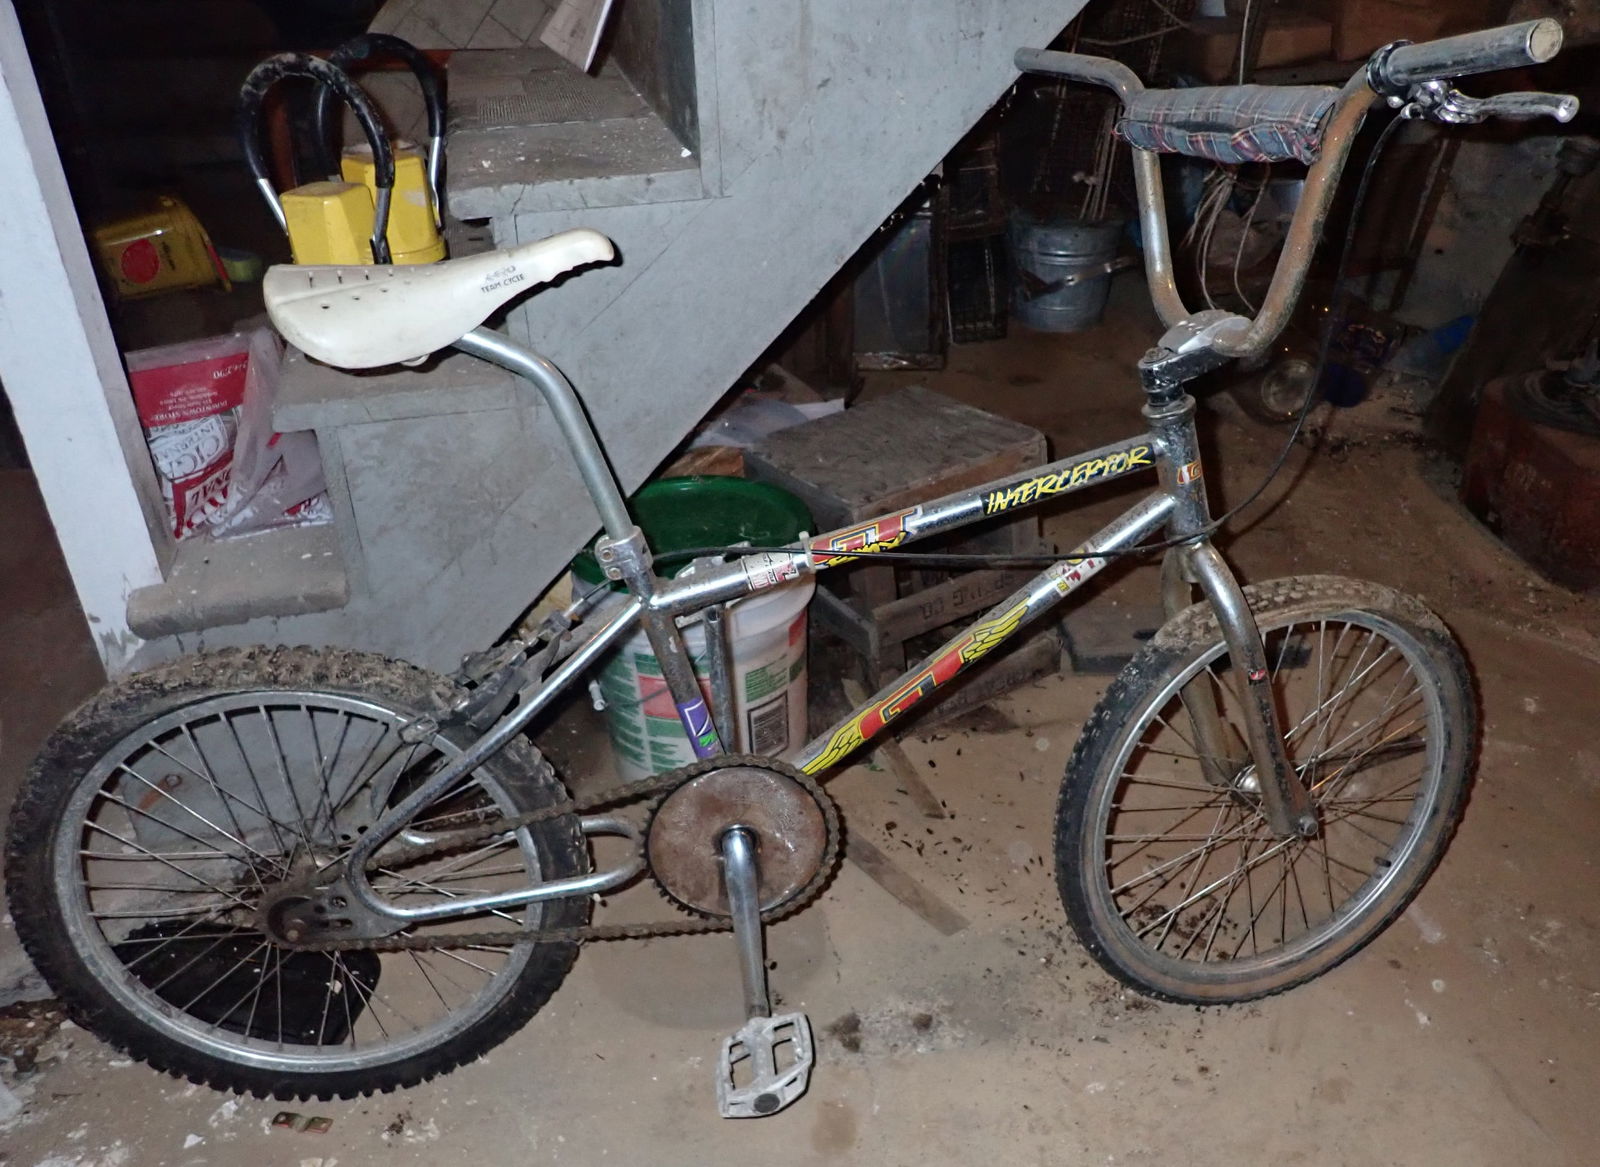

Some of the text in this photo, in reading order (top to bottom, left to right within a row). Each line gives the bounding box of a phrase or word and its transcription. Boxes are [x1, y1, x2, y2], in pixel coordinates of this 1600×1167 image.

[481, 273, 524, 293] TEAM CYCLE
[987, 446, 1151, 515] INTERCEPTOR
